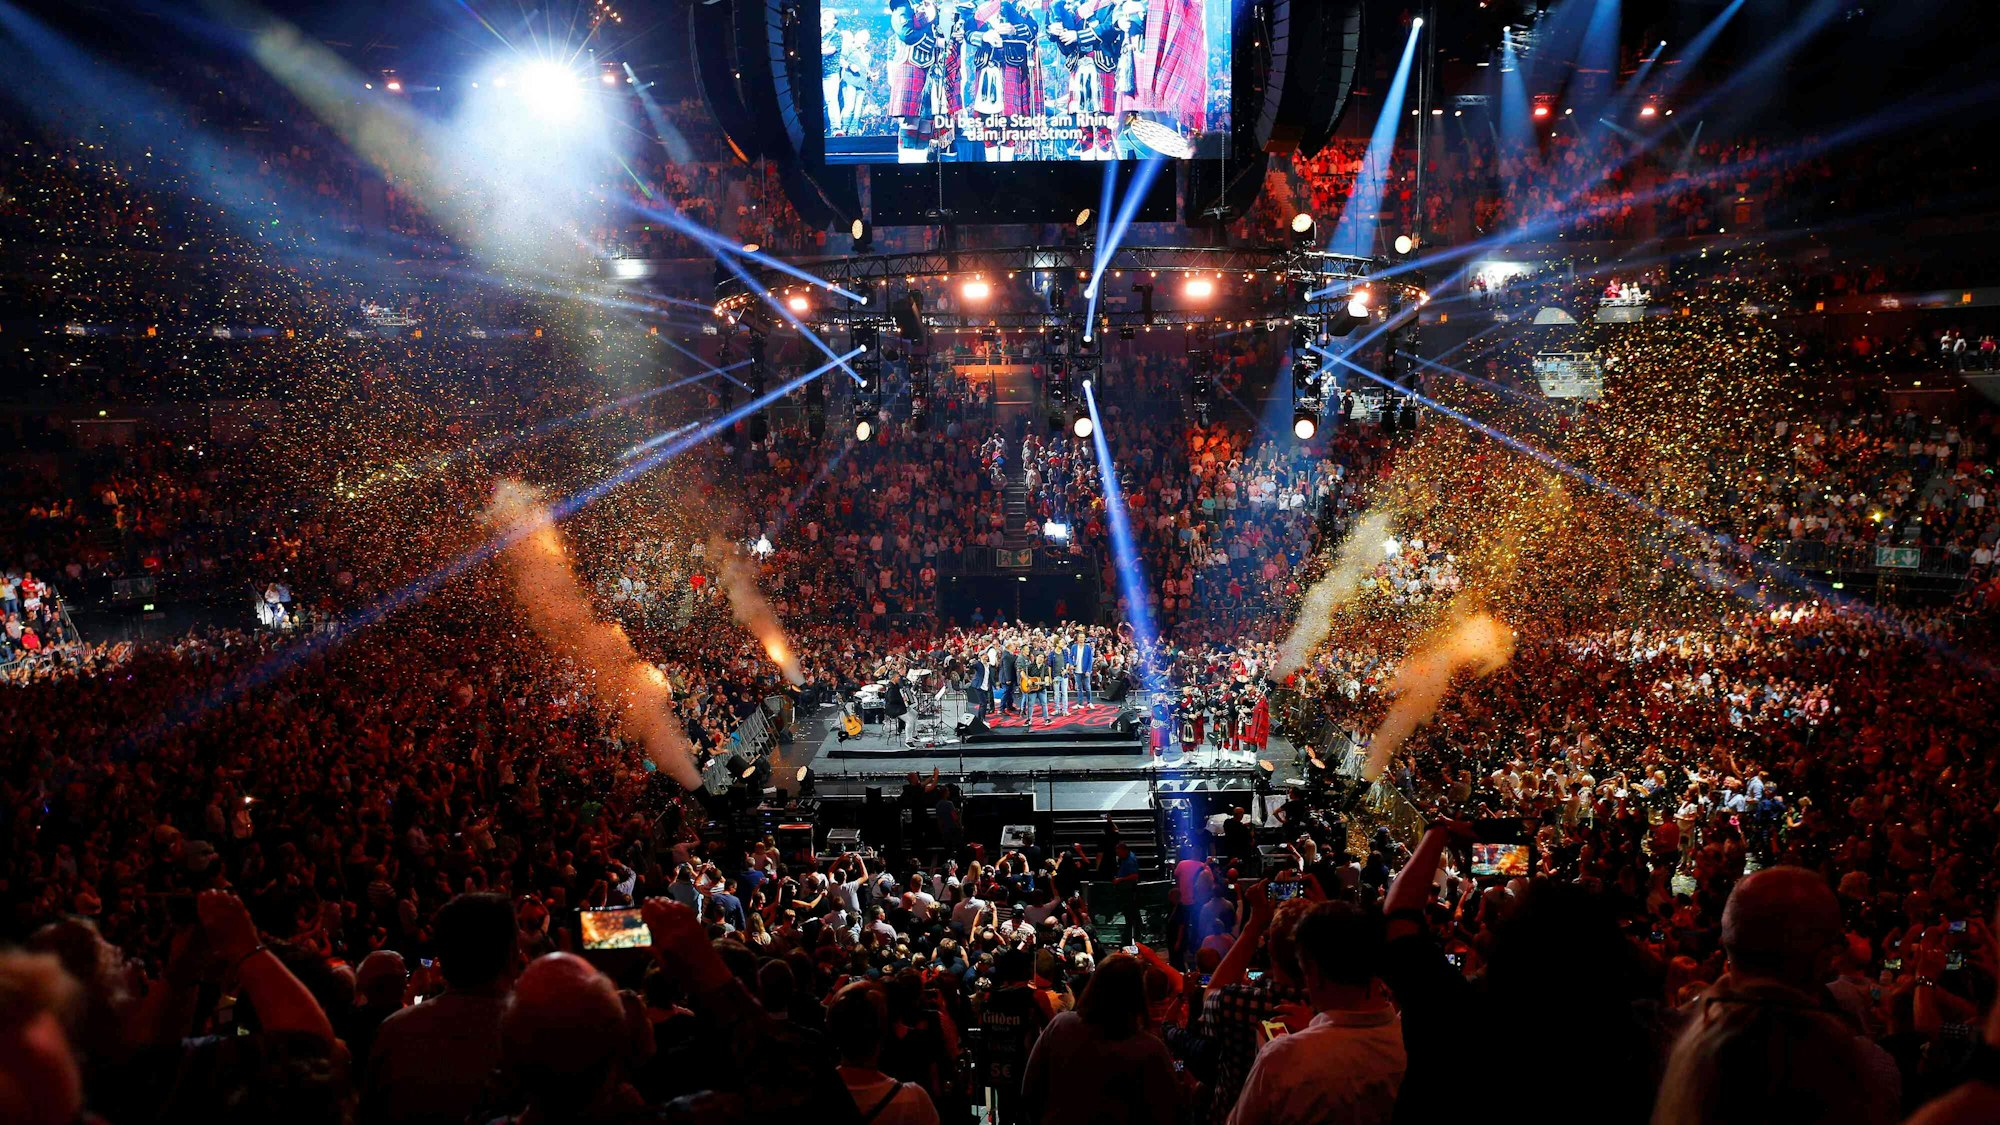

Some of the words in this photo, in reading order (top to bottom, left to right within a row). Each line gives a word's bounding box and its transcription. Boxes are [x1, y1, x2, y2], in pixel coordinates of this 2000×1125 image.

[934, 115, 954, 128] Du
[957, 114, 983, 128] bes
[986, 113, 1007, 128] die
[1010, 113, 1046, 128] Stadt
[1050, 116, 1072, 127] am
[1002, 127, 1036, 142] jraue
[1040, 127, 1087, 142] Strom,
